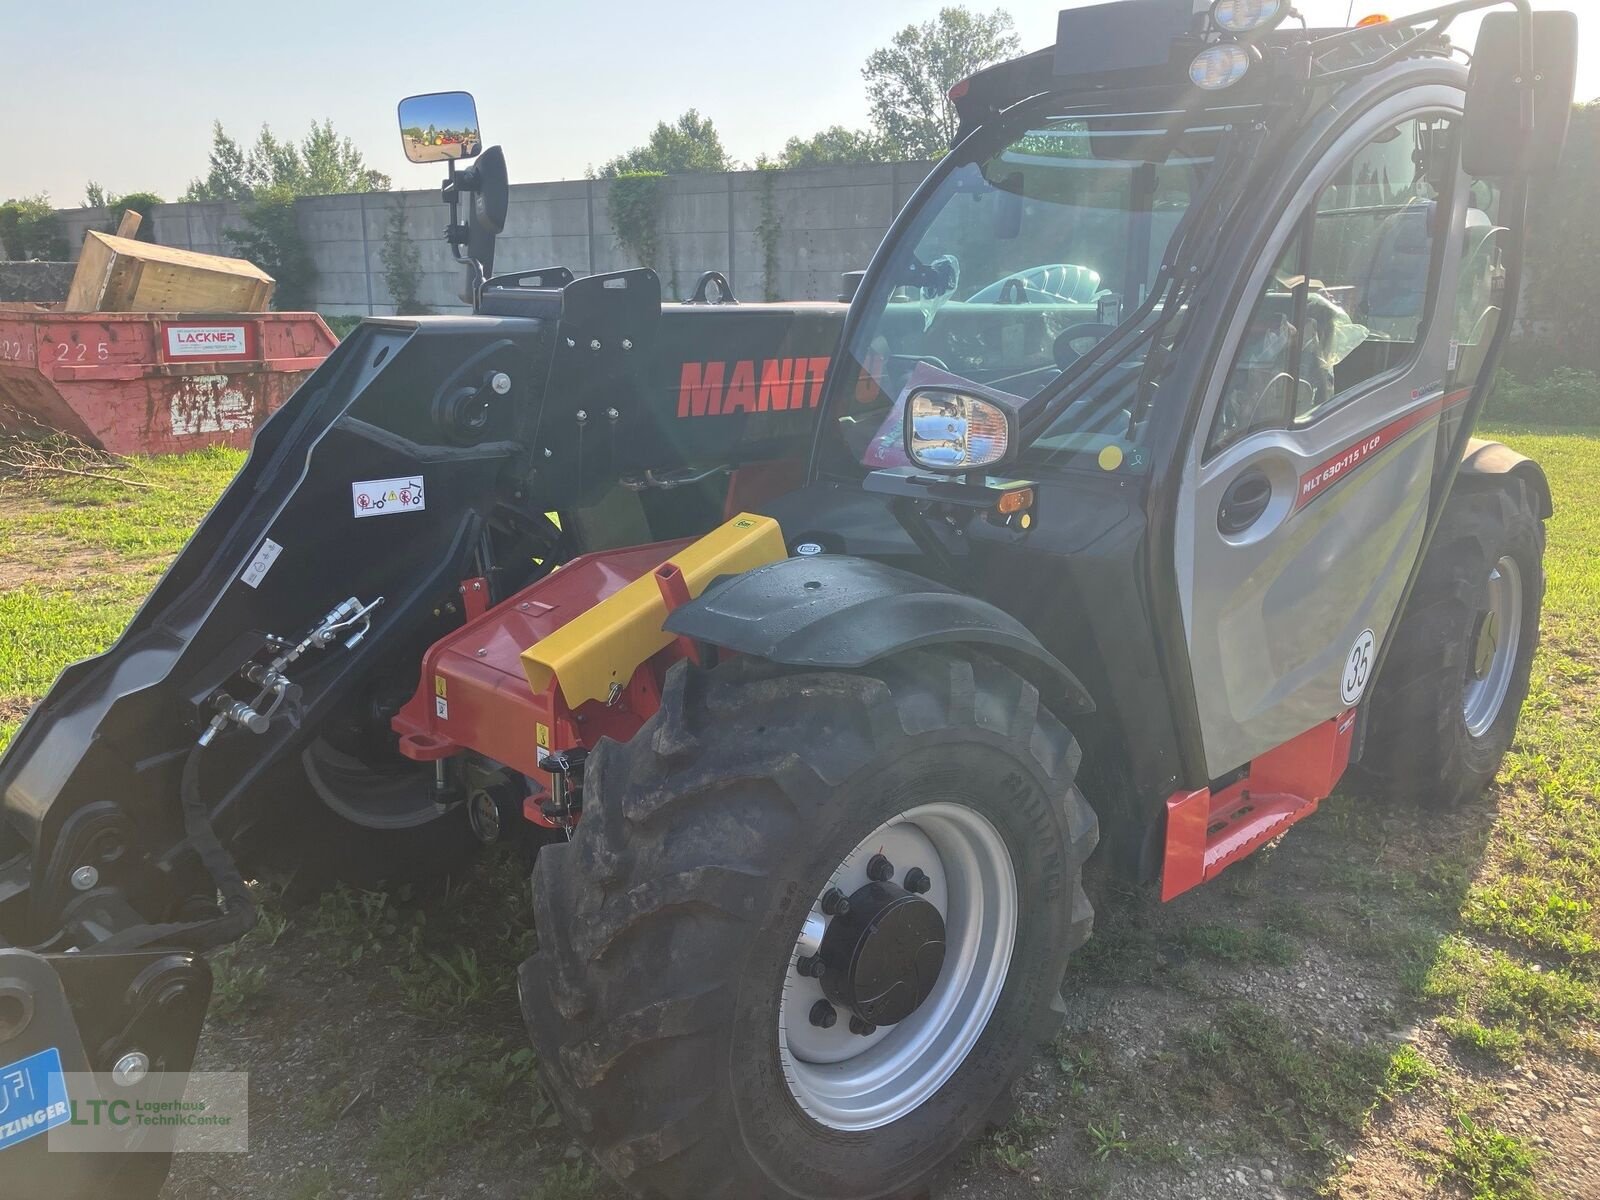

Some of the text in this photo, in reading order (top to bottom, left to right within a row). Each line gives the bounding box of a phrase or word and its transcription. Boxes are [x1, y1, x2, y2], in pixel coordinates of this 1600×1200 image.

[57, 342, 109, 361] 225
[177, 333, 236, 343] LACKNER
[1303, 474, 1322, 494] MLT
[1362, 435, 1380, 455] VCP
[1347, 641, 1371, 692] 35
